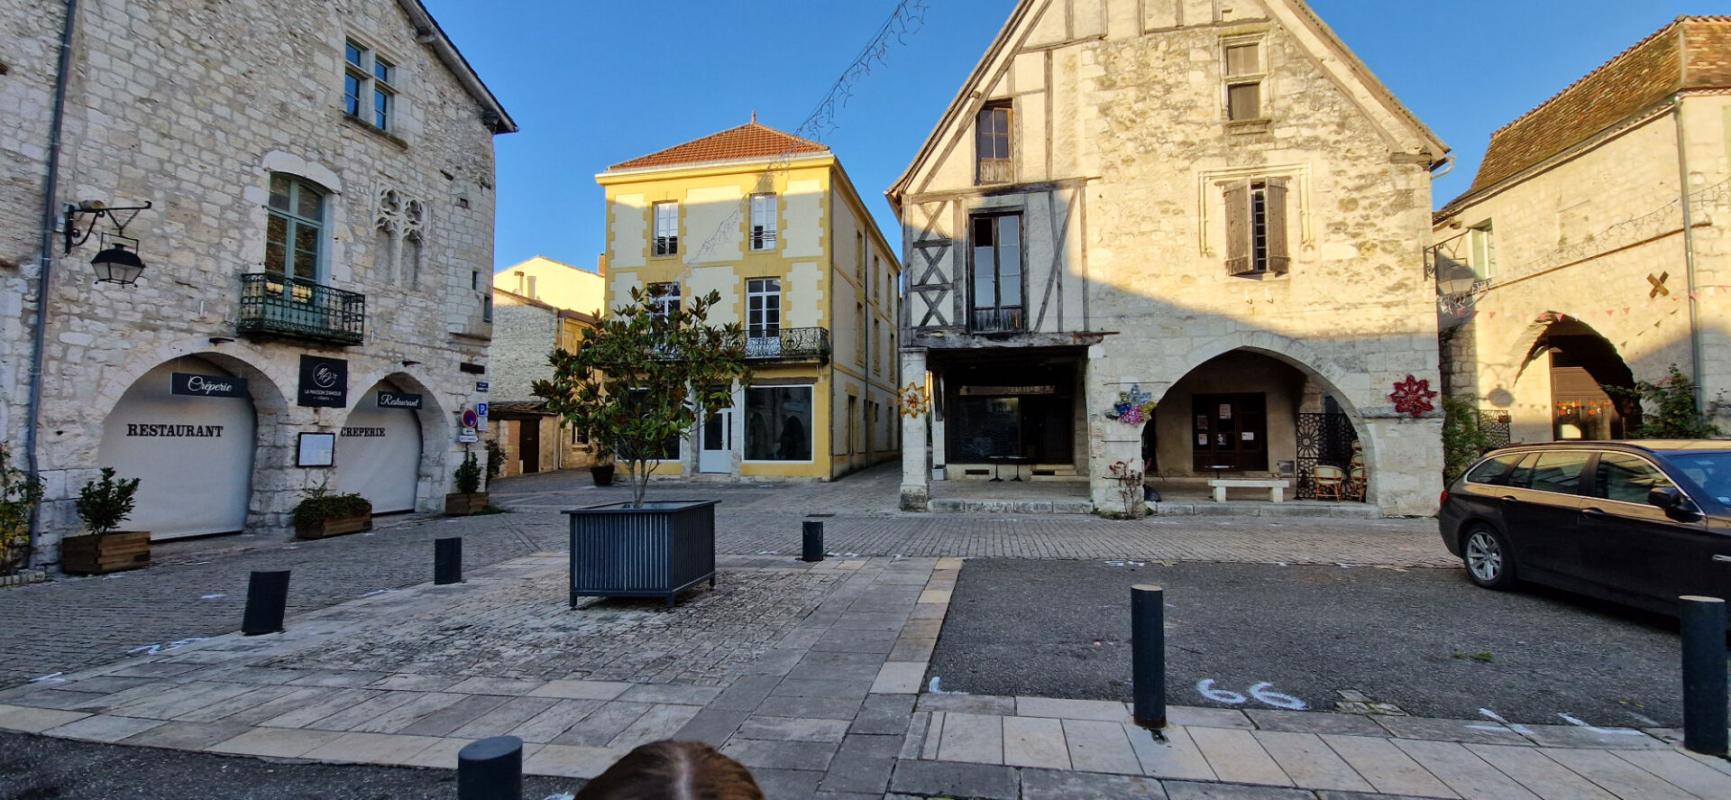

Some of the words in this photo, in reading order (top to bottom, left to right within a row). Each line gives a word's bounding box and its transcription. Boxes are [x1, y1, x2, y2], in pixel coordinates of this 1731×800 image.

[380, 394, 419, 407] Restaurant
[126, 423, 224, 437] RESTAURANT
[340, 426, 386, 437] CREPERIE
[1197, 679, 1309, 710] 66
